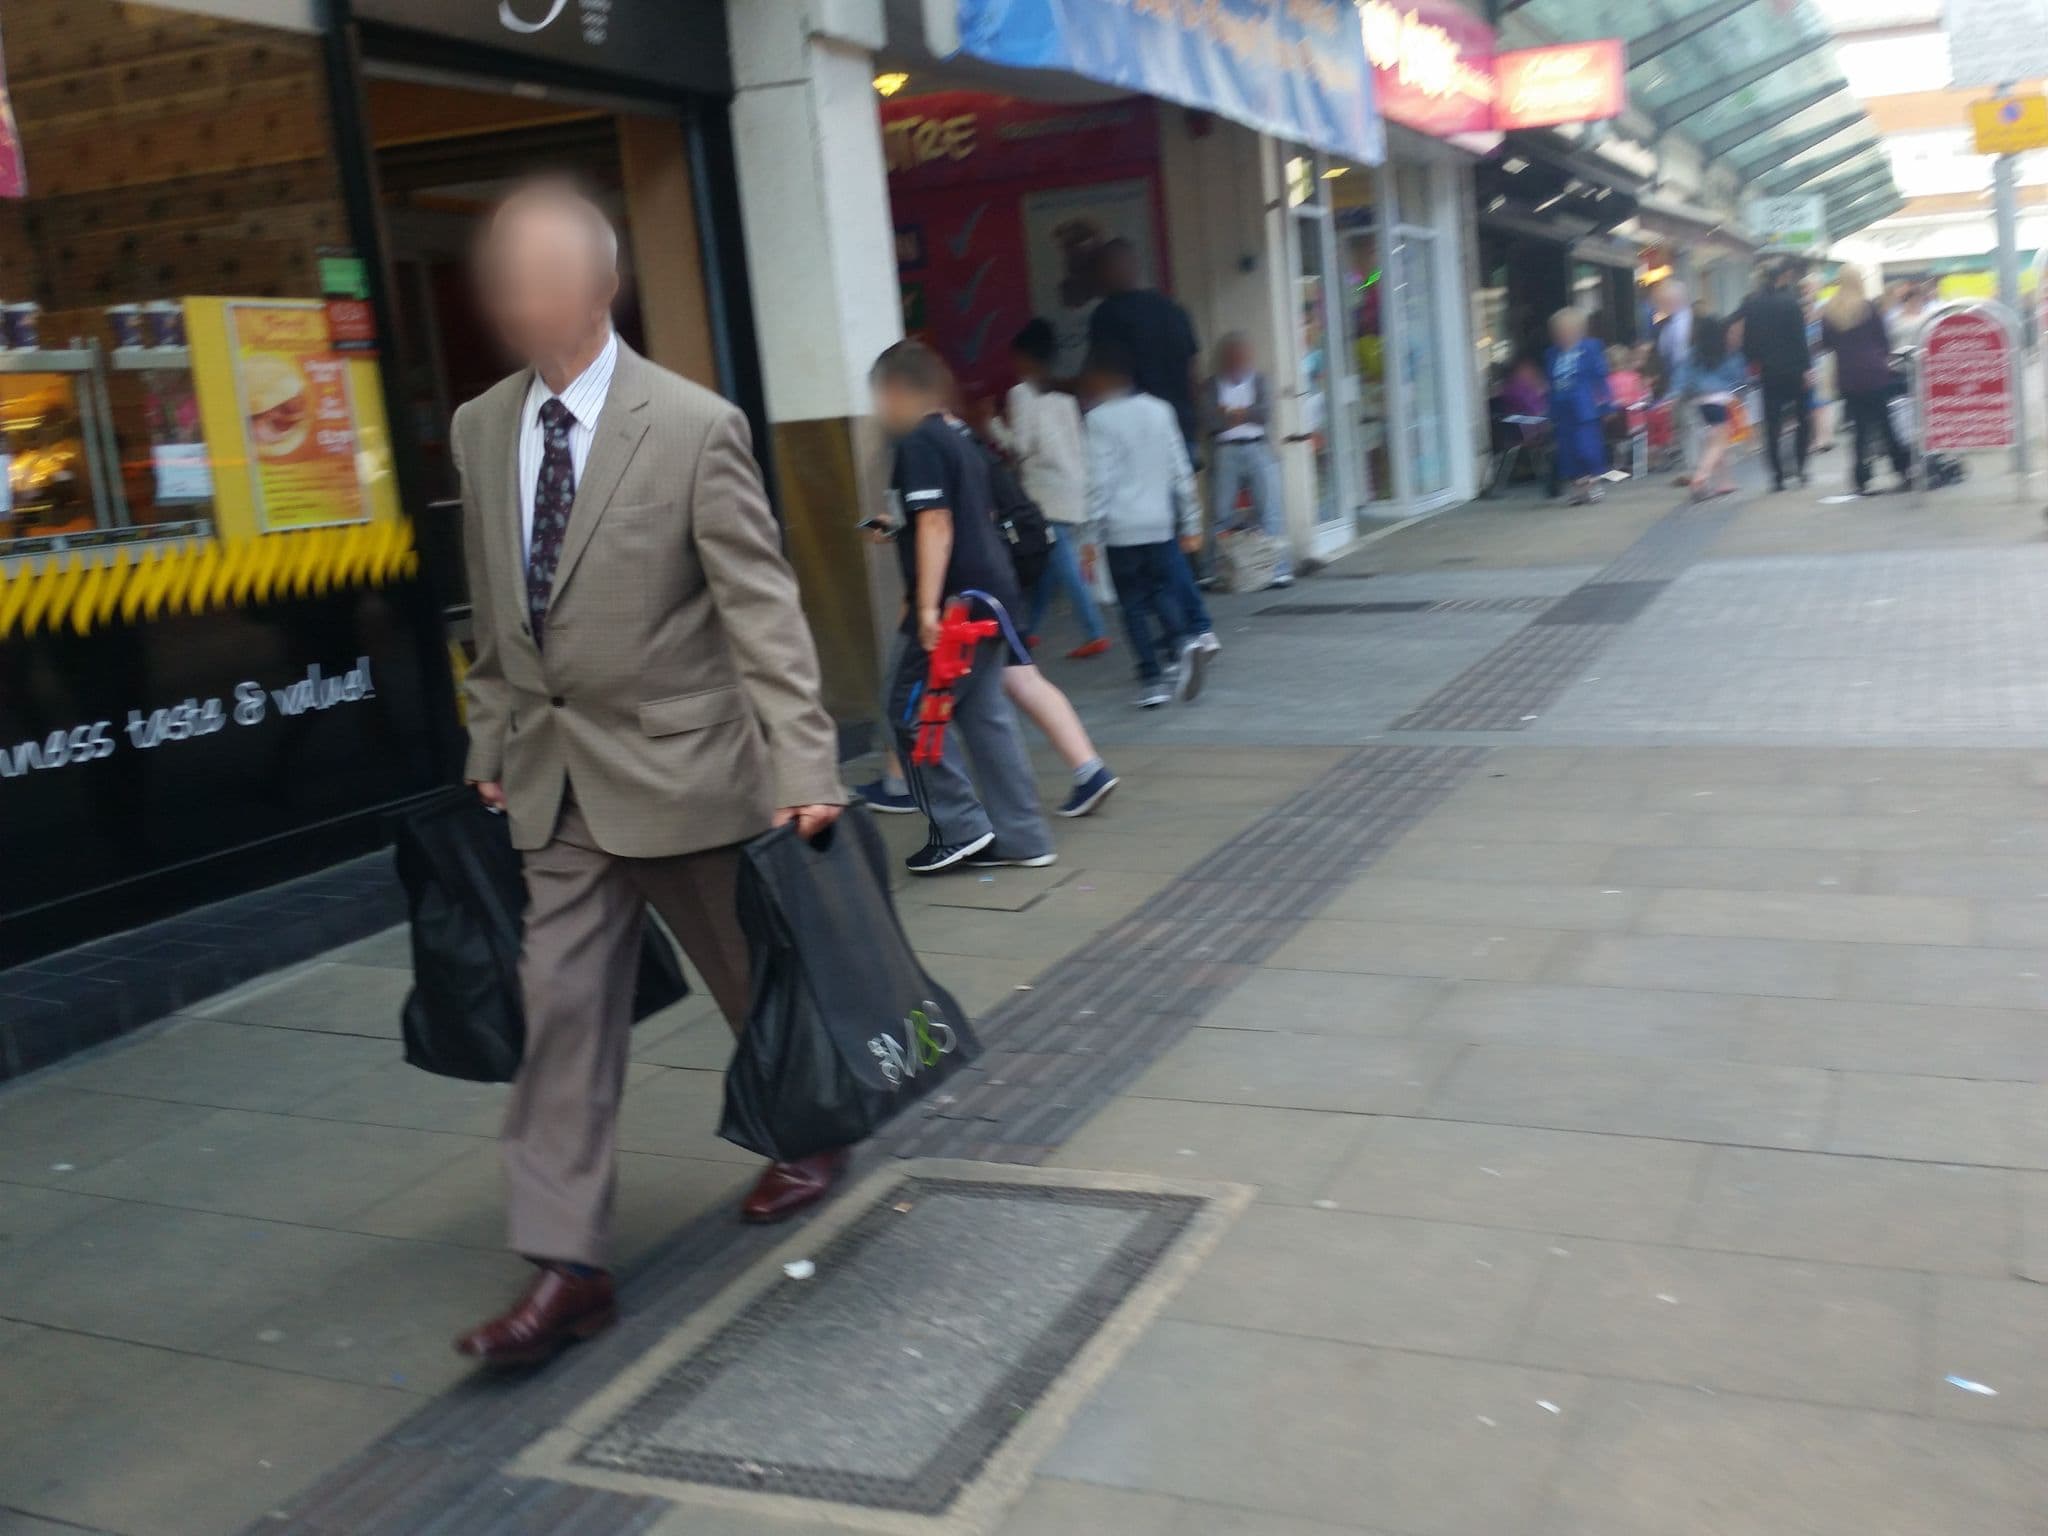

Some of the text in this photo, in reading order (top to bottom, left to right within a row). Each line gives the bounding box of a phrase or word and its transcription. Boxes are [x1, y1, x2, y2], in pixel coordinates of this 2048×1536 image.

[0, 720, 116, 777] ness
[125, 698, 227, 748] taste
[233, 681, 267, 726] &
